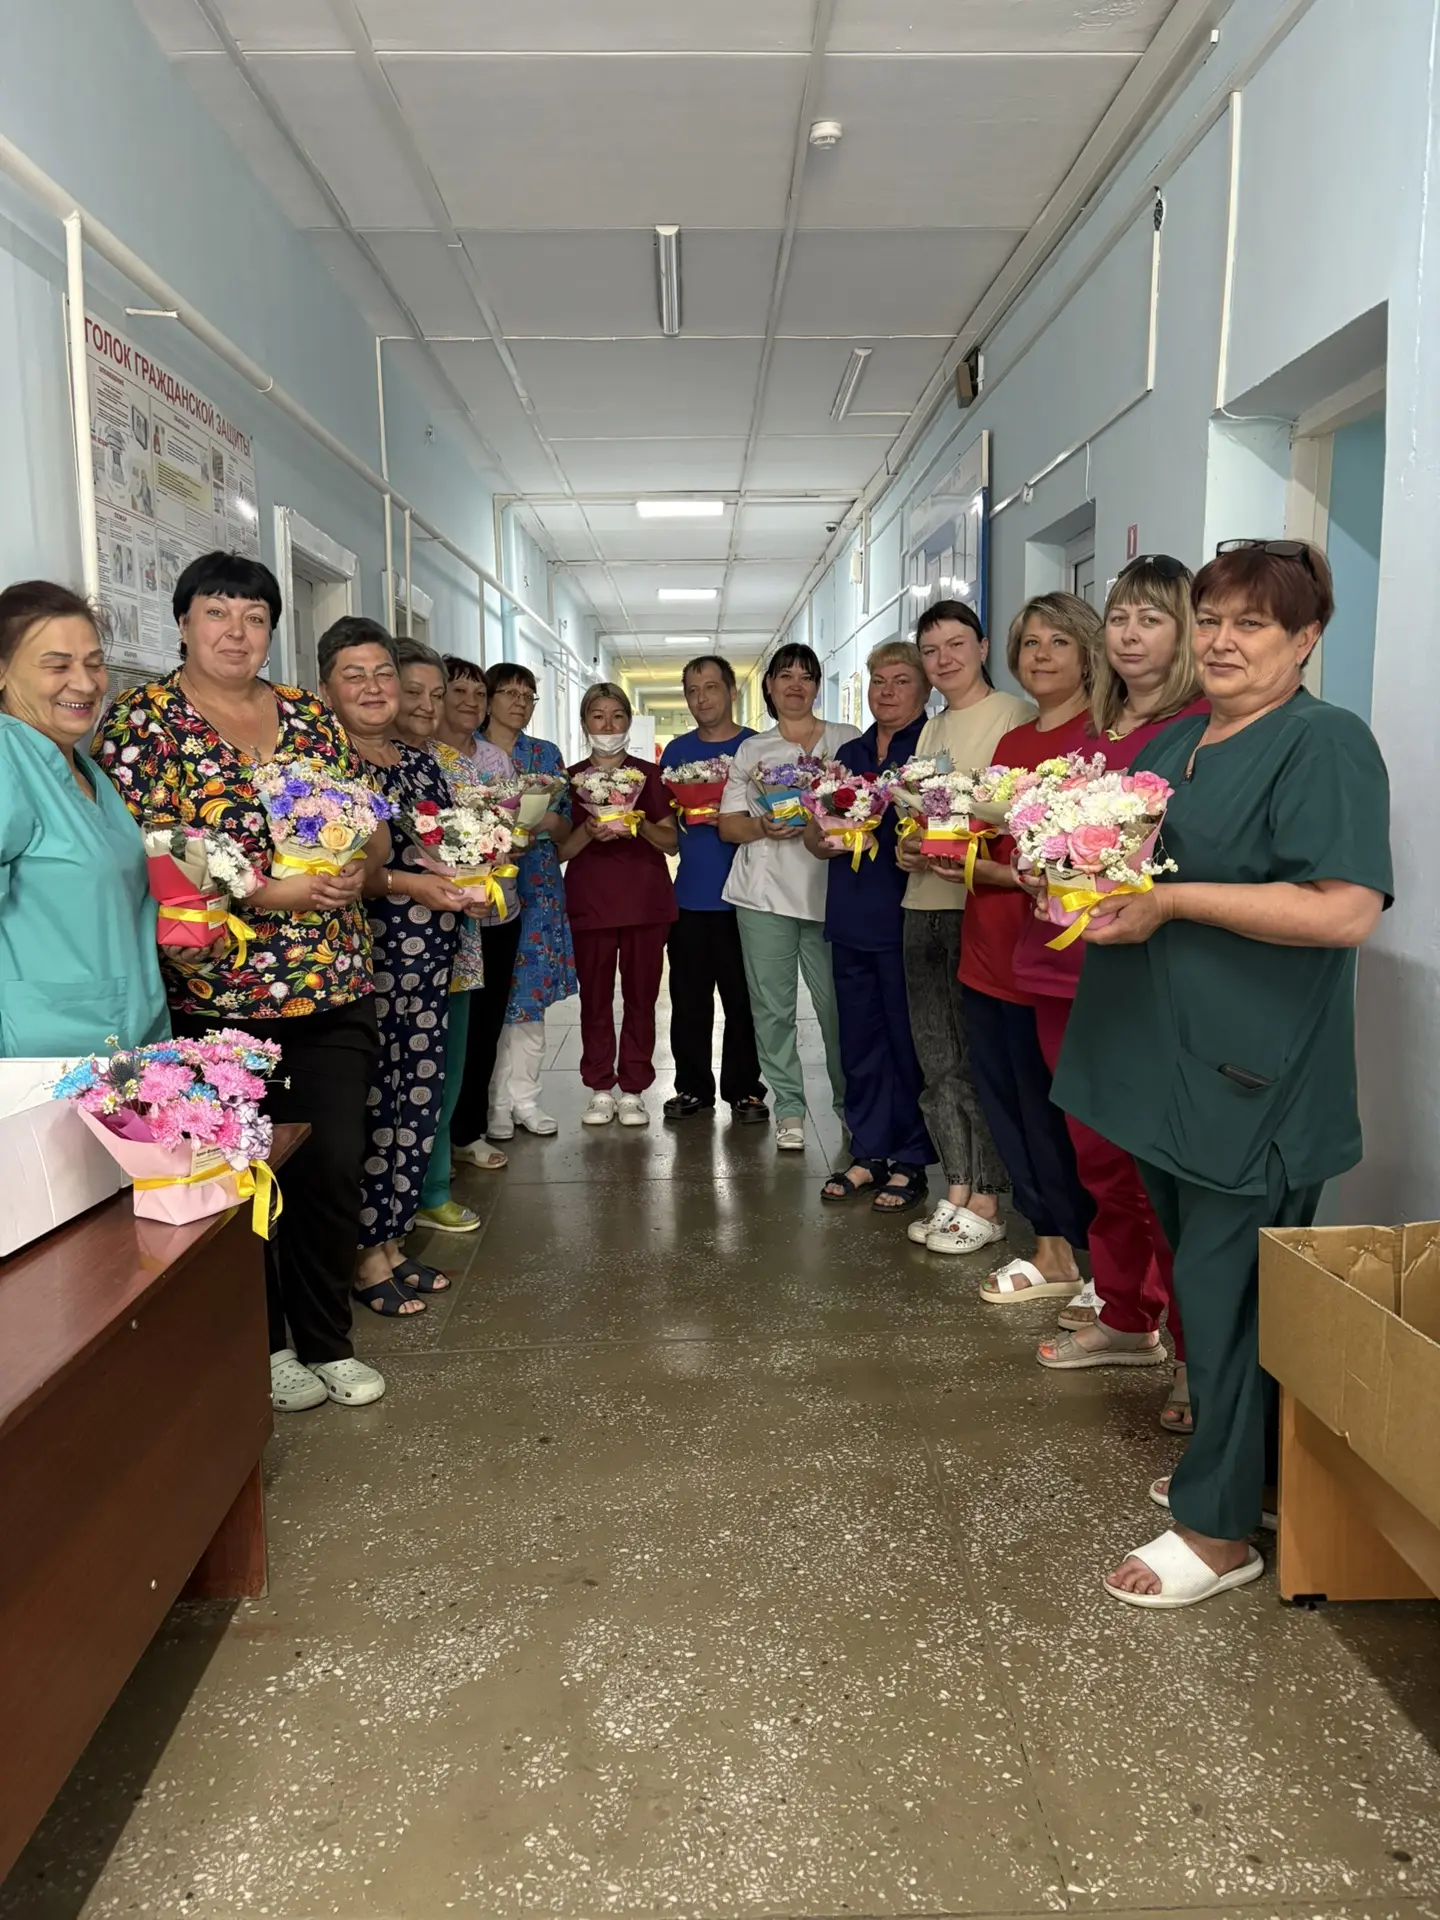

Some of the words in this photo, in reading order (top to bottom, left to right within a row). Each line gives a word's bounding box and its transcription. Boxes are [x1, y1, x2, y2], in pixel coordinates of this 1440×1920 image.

[84, 316, 131, 371] ГОЛОК
[134, 351, 214, 430] ГРАЖДАНСКОЙ
[216, 413, 251, 458] ЗАЩИТЫ
